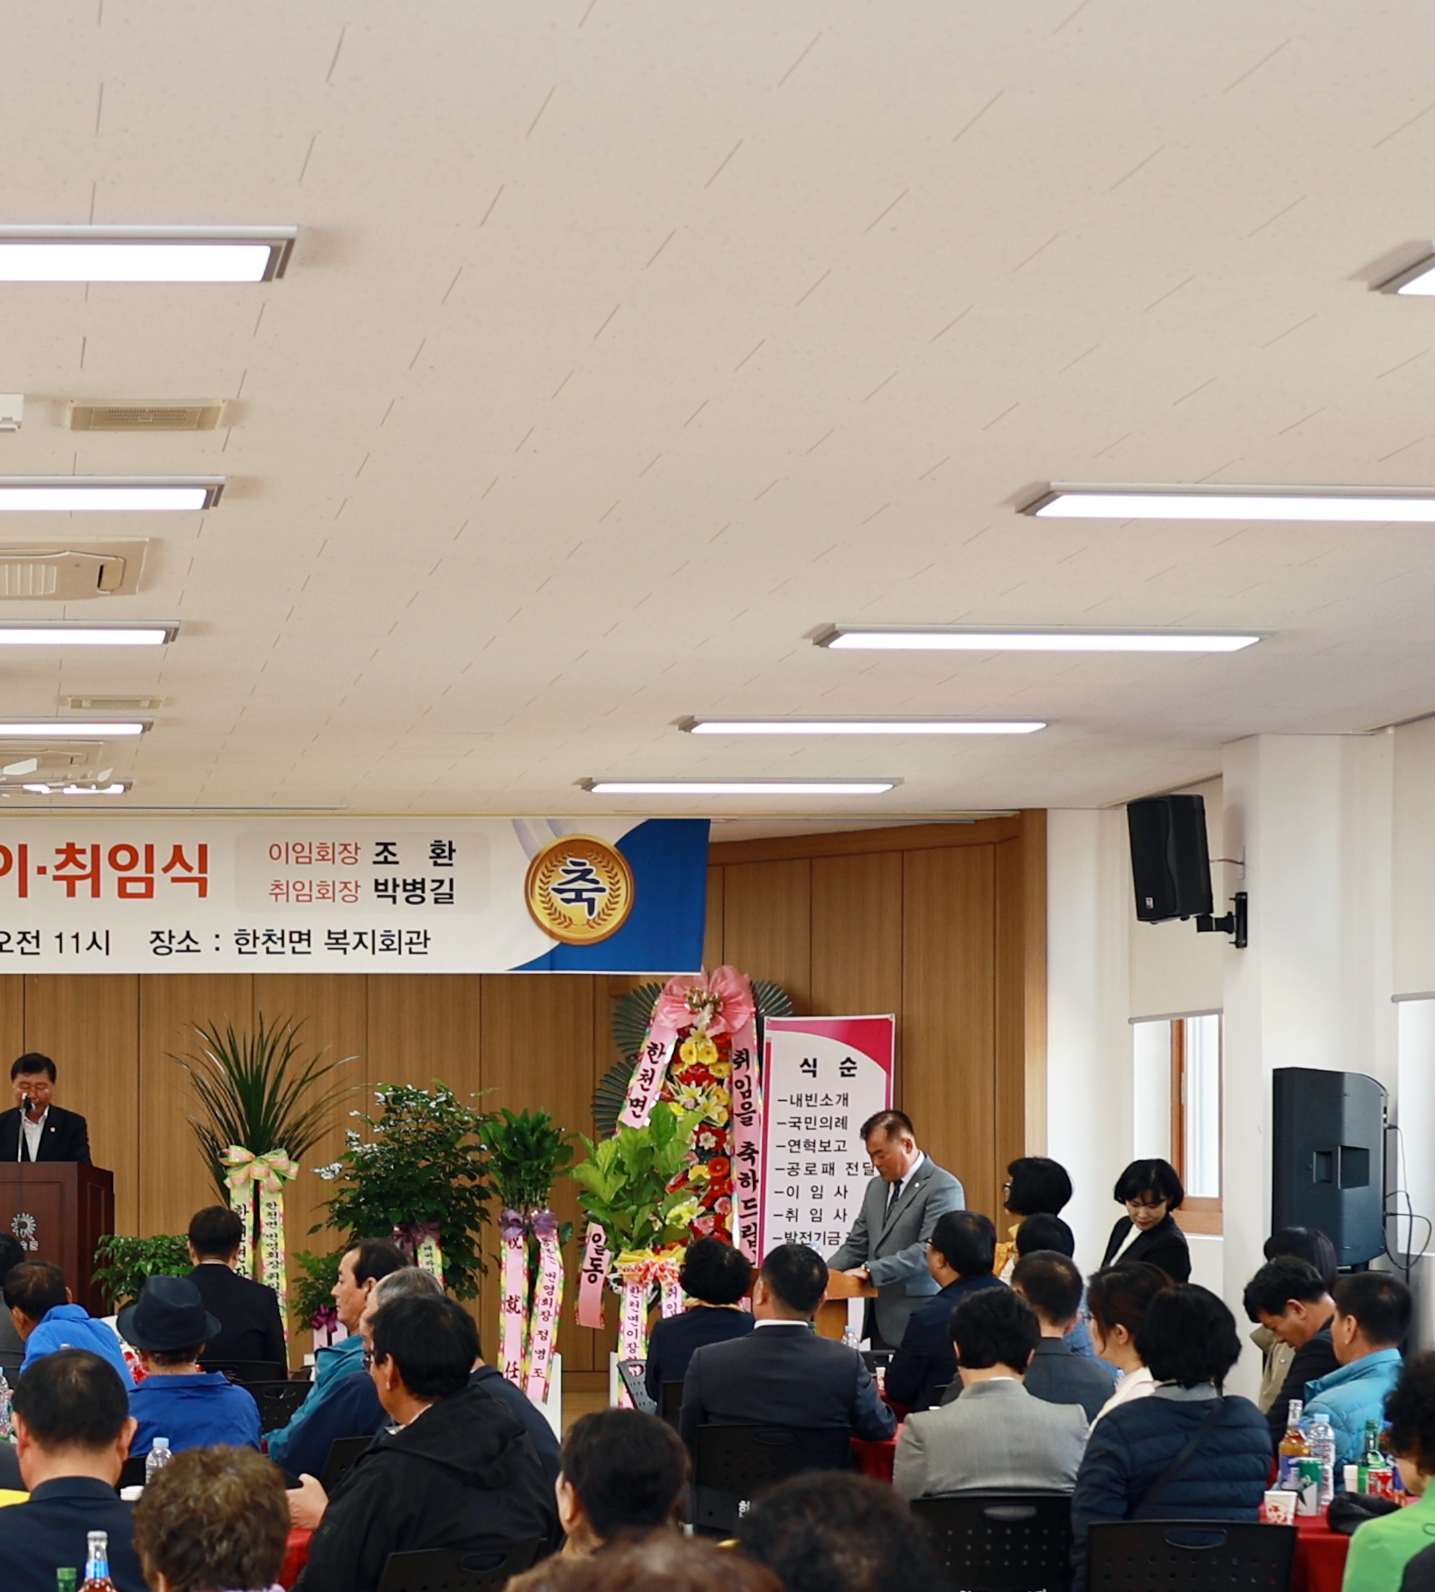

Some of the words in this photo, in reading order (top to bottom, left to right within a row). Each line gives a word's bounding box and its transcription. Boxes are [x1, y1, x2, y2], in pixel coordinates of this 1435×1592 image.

[268, 840, 361, 868] 이임회장
[373, 840, 400, 866] 조
[430, 839, 457, 868] 환
[268, 878, 362, 904] 취임회장
[373, 876, 456, 906] 박병길
[551, 860, 607, 917] 축
[54, 929, 110, 957] 11시
[149, 929, 202, 957] 장소
[233, 928, 312, 956] 한천면
[324, 929, 431, 956] 복지회관
[630, 1042, 666, 1119] 한천면
[799, 1057, 818, 1078] 식
[839, 1057, 858, 1078] 순
[731, 1048, 757, 1126] 취임을
